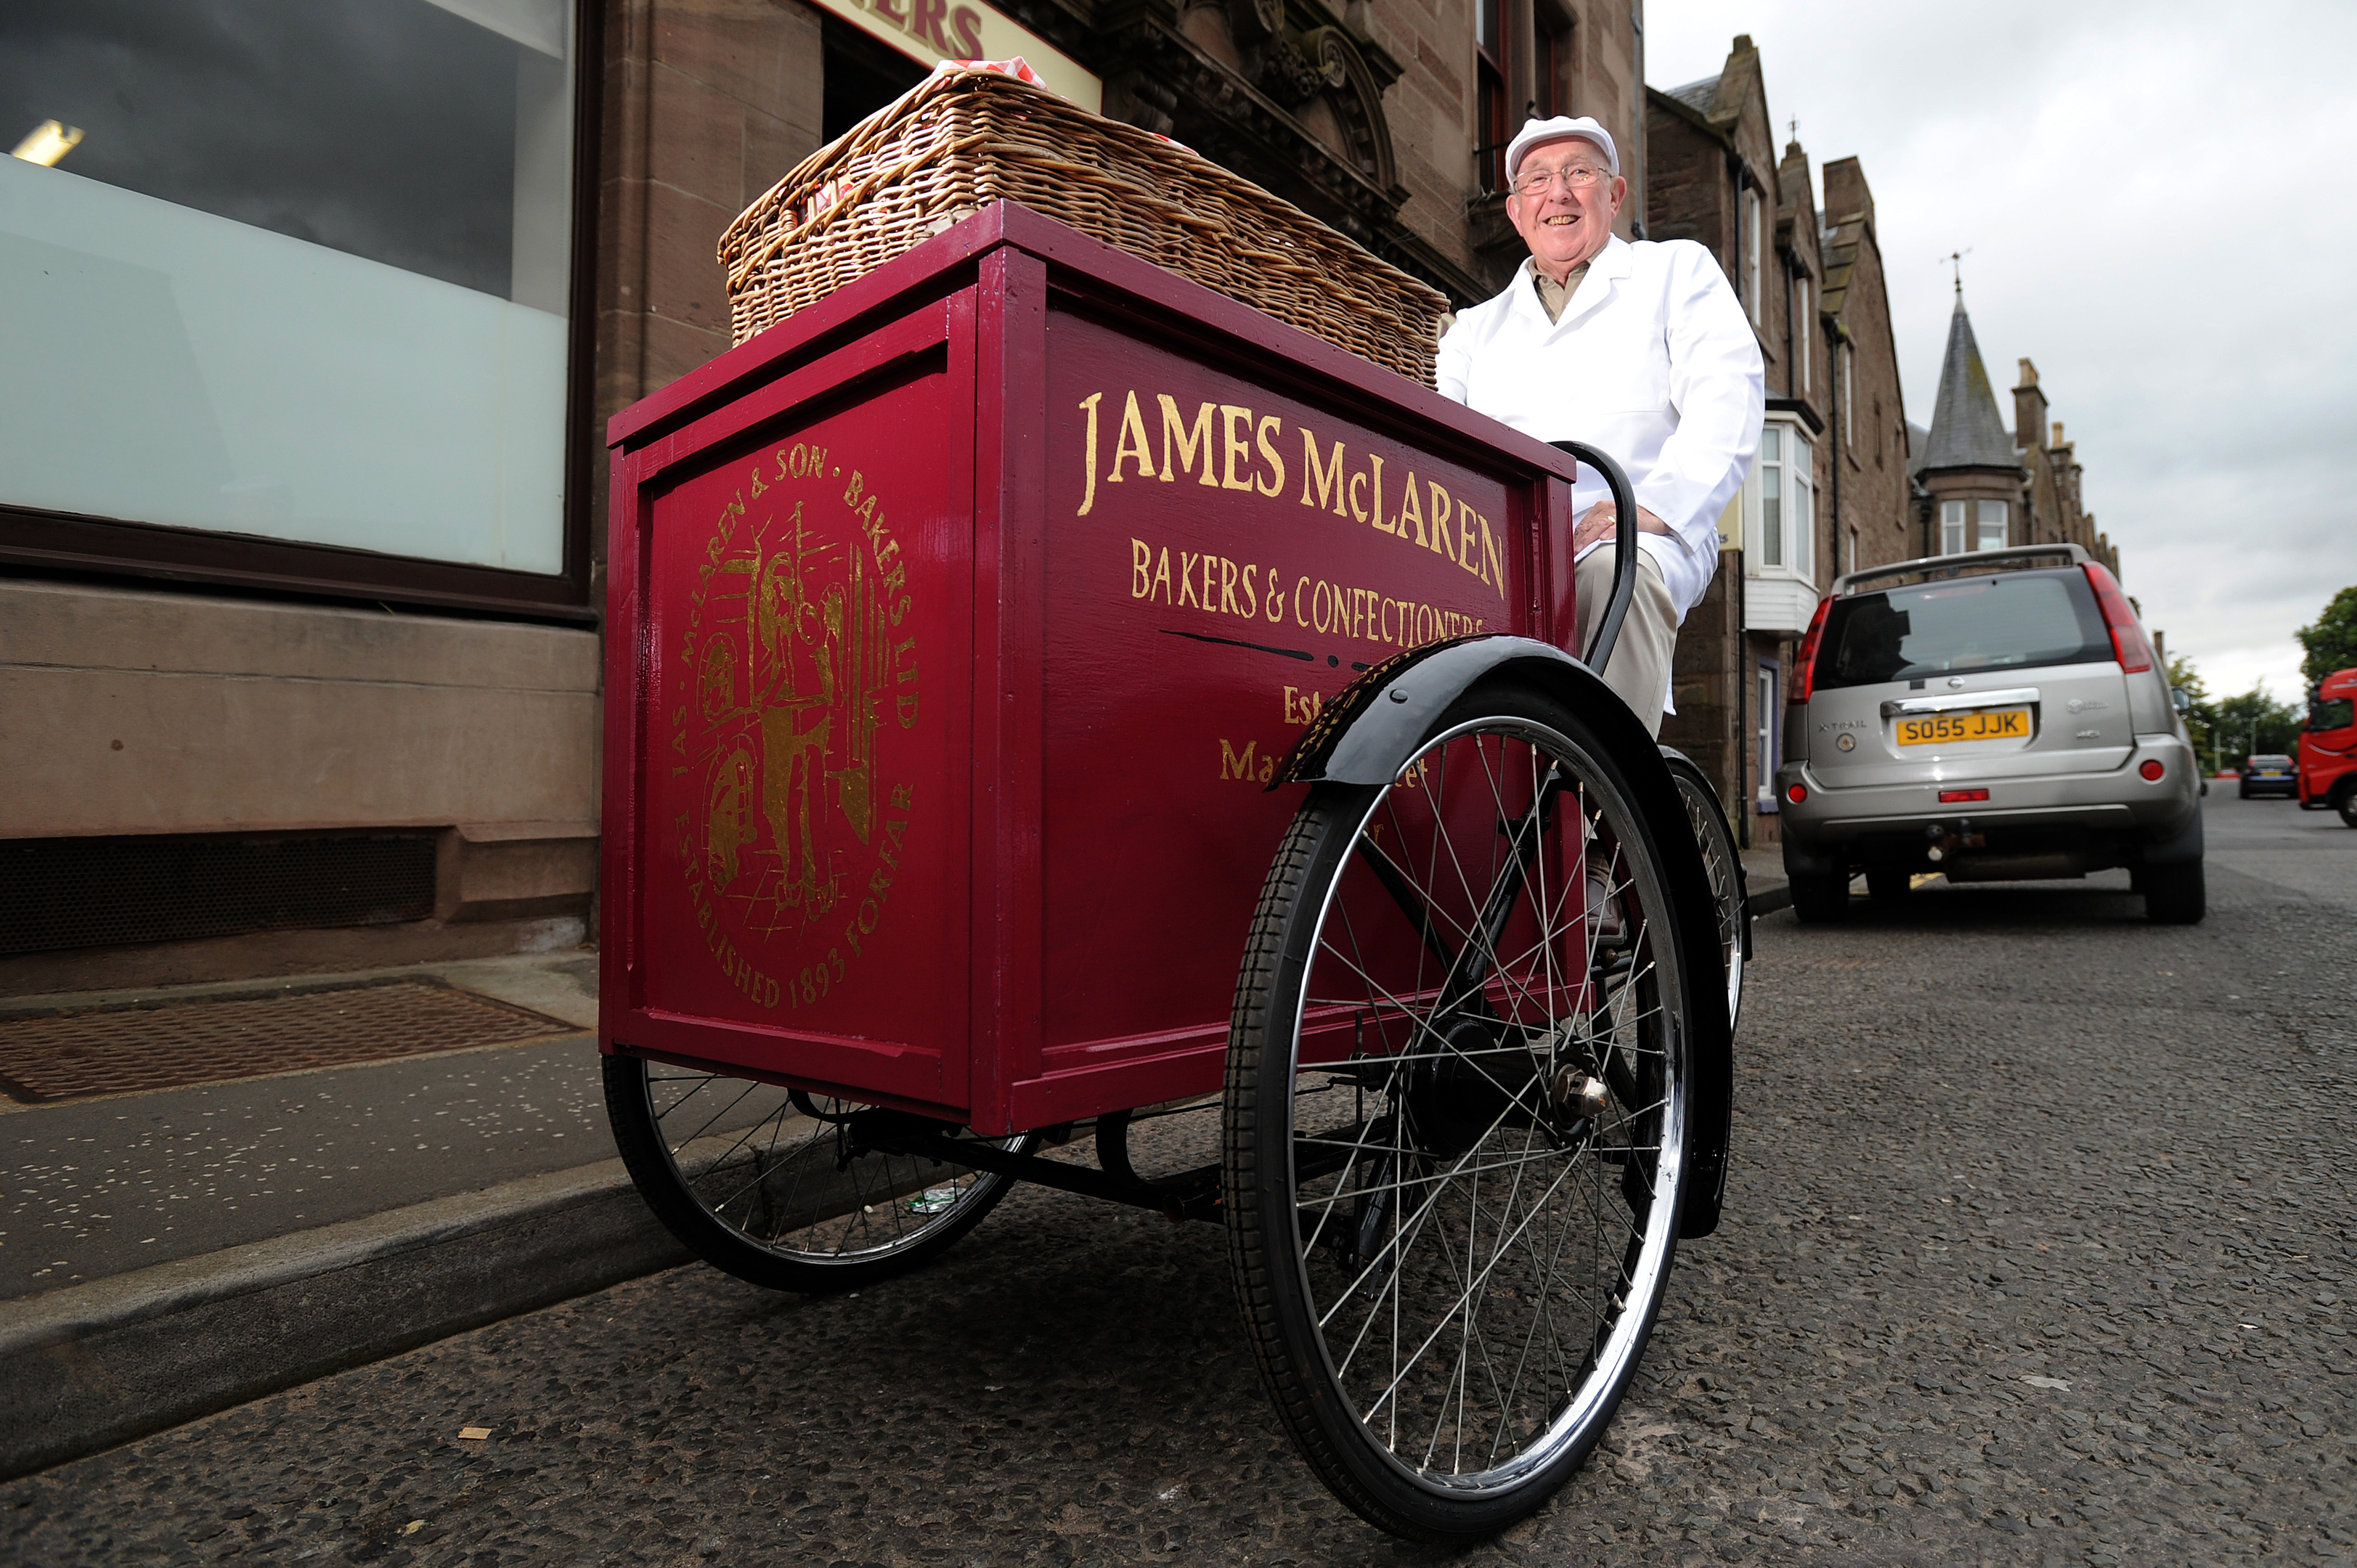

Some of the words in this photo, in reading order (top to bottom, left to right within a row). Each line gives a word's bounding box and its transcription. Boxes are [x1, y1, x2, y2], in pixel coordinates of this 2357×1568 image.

[751, 467, 770, 499] &
[775, 443, 828, 481] SON
[843, 469, 912, 626] BAKERS
[894, 636, 919, 728] LTD
[1078, 390, 1285, 516] JAMES
[1298, 426, 1505, 601] McLAREN
[1131, 537, 1257, 618] BAKERS
[1266, 568, 1284, 623] &
[1974, 714, 2019, 735] JJK
[675, 810, 780, 1009] ESTABLISHED
[790, 947, 846, 1009] 1893
[844, 783, 914, 958] FORFAR
